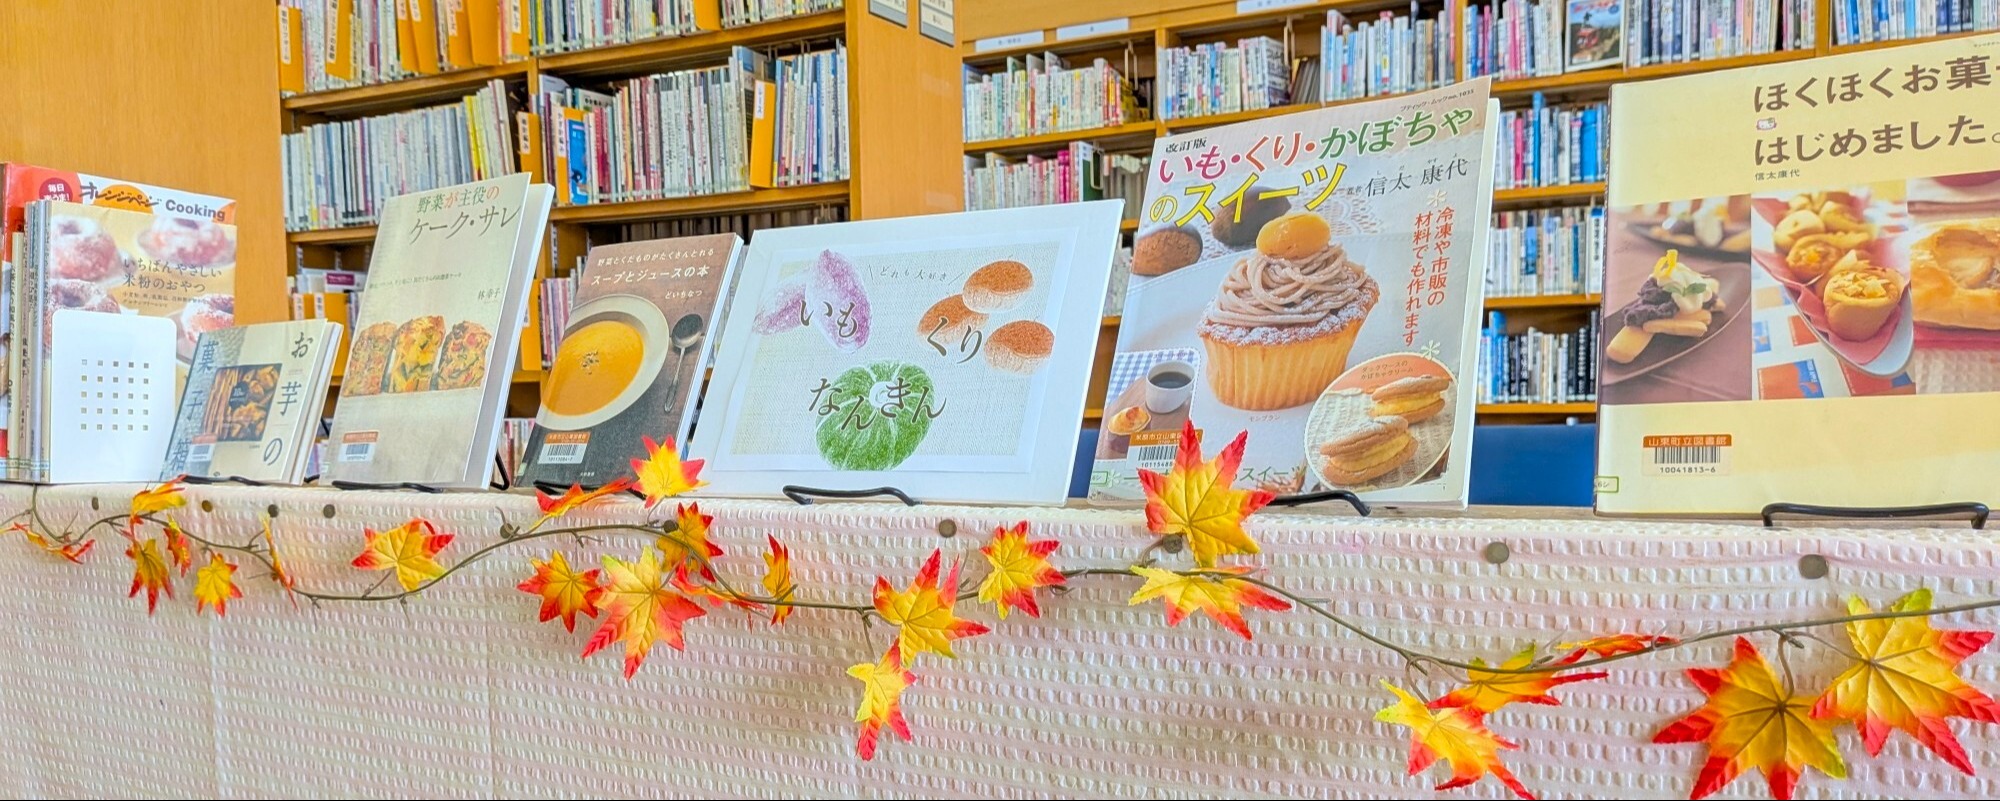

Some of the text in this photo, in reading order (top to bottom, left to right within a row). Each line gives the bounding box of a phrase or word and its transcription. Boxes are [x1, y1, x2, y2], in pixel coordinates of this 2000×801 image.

[1754, 54, 2000, 113] ほくほくお菓
[1158, 107, 1474, 184] いも・くり・かぼちゃ
[1165, 136, 1207, 153] 改訂版
[1754, 169, 1800, 182] 信太康代
[48, 183, 65, 192] 毎日
[1149, 163, 1348, 228] のスイーツ
[165, 199, 226, 221] Cooking
[416, 185, 500, 214] 野菜が主役の
[409, 204, 522, 246] ケーク・サレ
[124, 257, 222, 278] いちばんやさしい
[597, 247, 714, 267] 野菜とくだものがたくさんとれる
[1427, 206, 1455, 307] 冷凍や市販の
[123, 273, 206, 293] 米粉のおやつ
[590, 264, 711, 286] スープとジュースの本
[1402, 211, 1432, 347] 材料でも作れます
[665, 289, 703, 300] どいちなつ
[800, 298, 858, 339] いも
[926, 316, 984, 365] くり
[808, 377, 948, 432] なんきん
[1648, 436, 1727, 447] 山東町立図書館
[1660, 466, 1716, 474] 10041813-6
